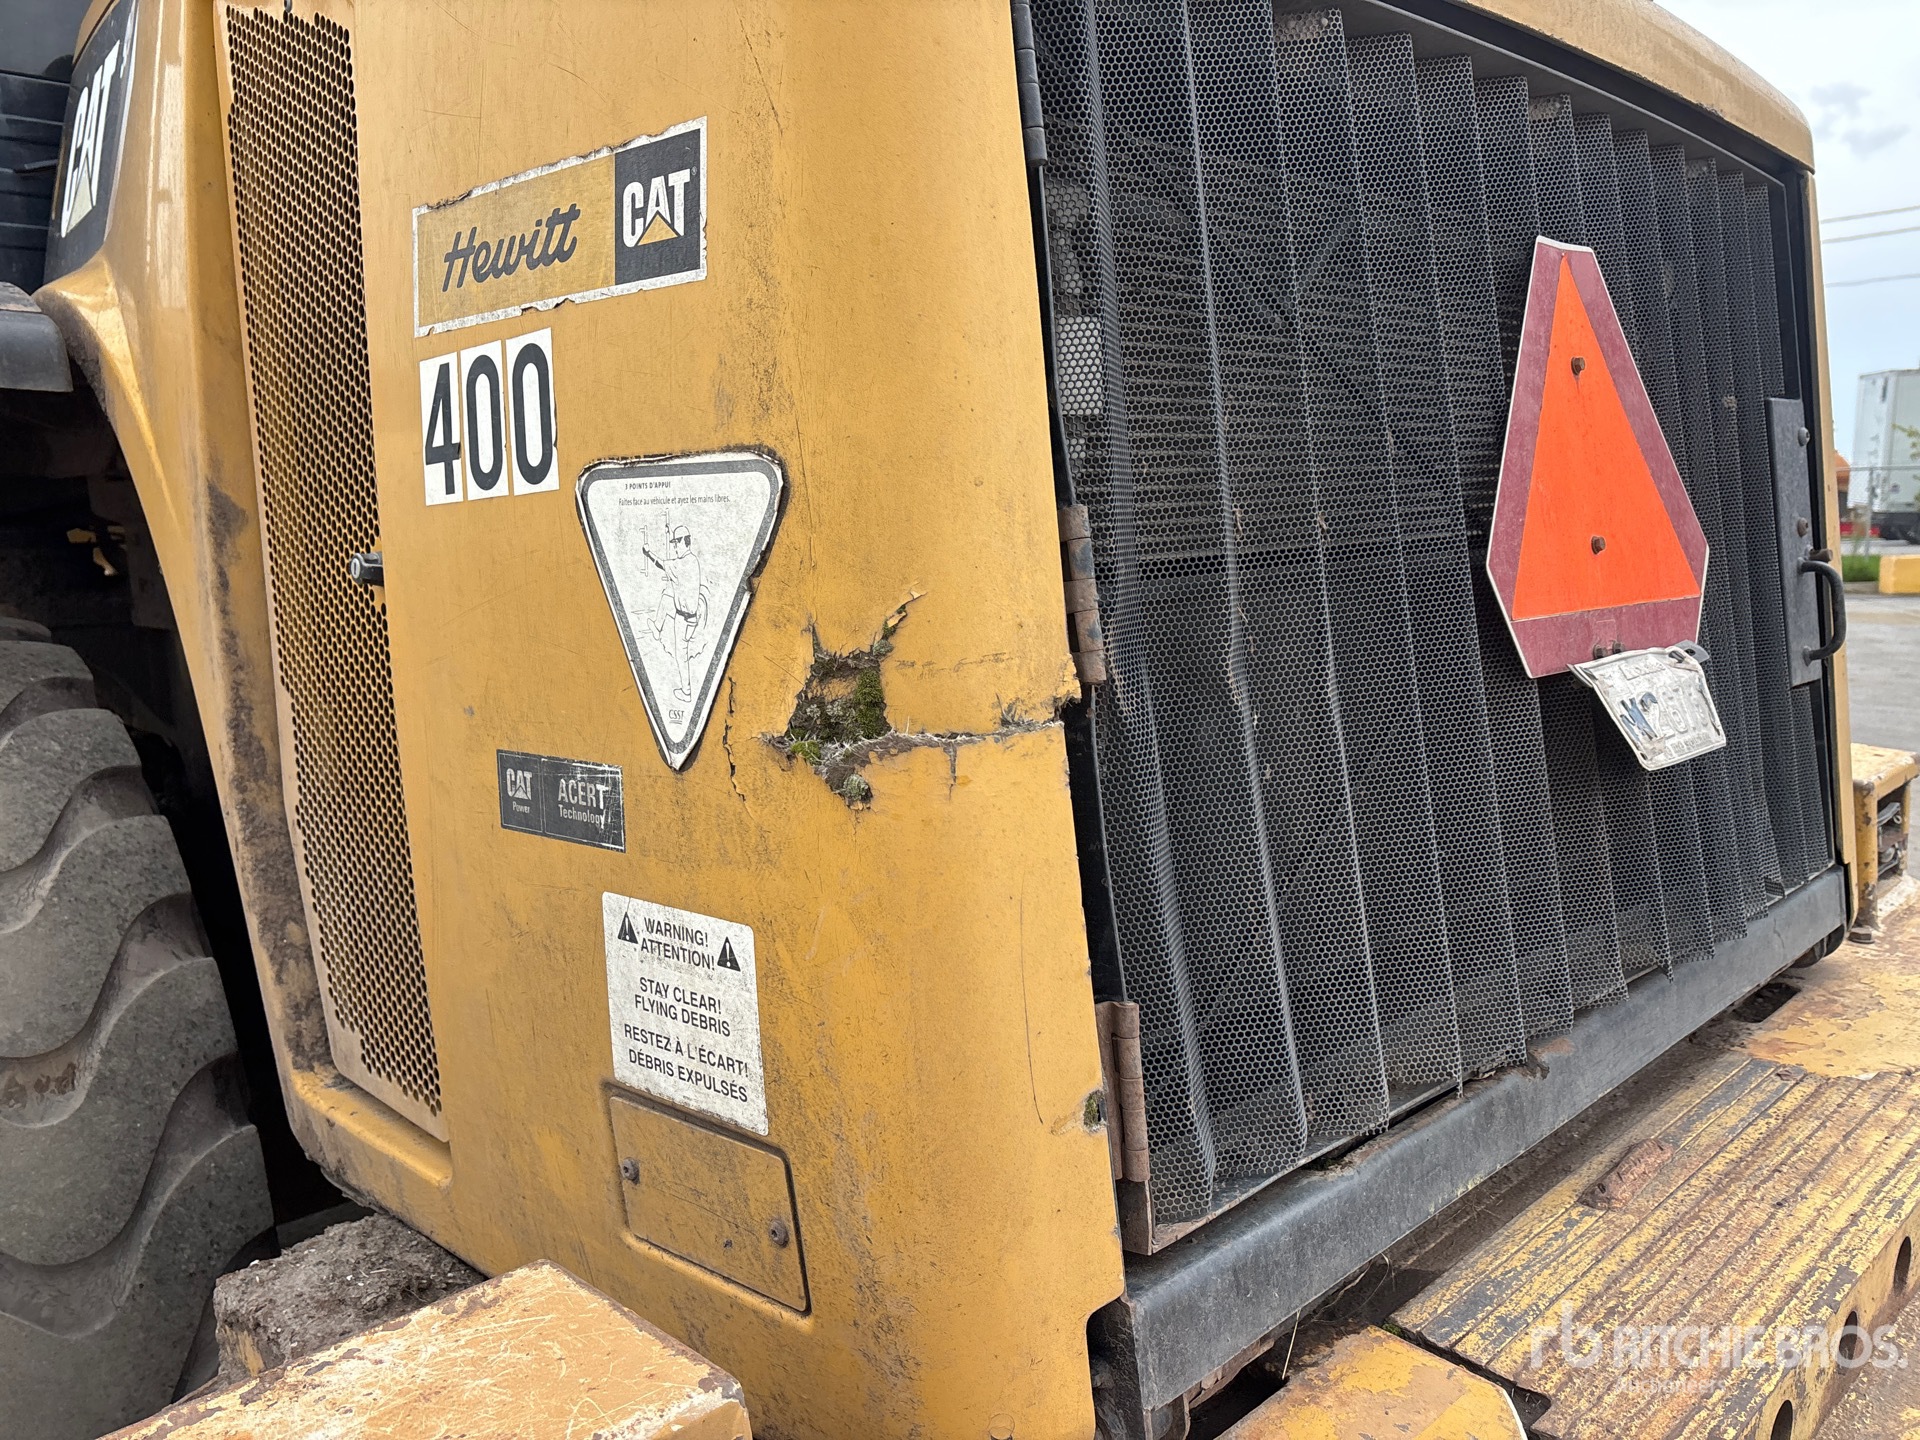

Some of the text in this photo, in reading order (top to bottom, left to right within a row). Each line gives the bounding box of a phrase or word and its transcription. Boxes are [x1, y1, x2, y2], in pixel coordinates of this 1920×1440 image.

[61, 40, 120, 238] CAT
[442, 167, 692, 293] Hewitt CAT
[424, 342, 554, 496] 400
[619, 497, 632, 506] Faites
[632, 496, 643, 506] face
[650, 496, 670, 505] véhicule
[671, 497, 677, 505] et
[677, 497, 689, 506] ayez
[689, 494, 697, 504] les
[697, 495, 714, 503] mains
[714, 494, 730, 503] libres.
[629, 482, 648, 490] POINTS
[649, 481, 671, 489] D'APPUI
[669, 709, 685, 720] CSST
[506, 768, 532, 801] CAT
[557, 778, 609, 810] ACERT
[512, 801, 530, 814] Power
[558, 804, 606, 830] Technology
[644, 917, 709, 948] WARNING!
[640, 938, 715, 971] ATTENTION!
[639, 976, 722, 1015] STAY CLEAR!
[635, 994, 731, 1037] FLYING DEBRIS
[624, 1024, 748, 1078] RESTEZ À L'ÉCART!
[629, 1049, 748, 1103] DÉBRIS EXPULSÉS
